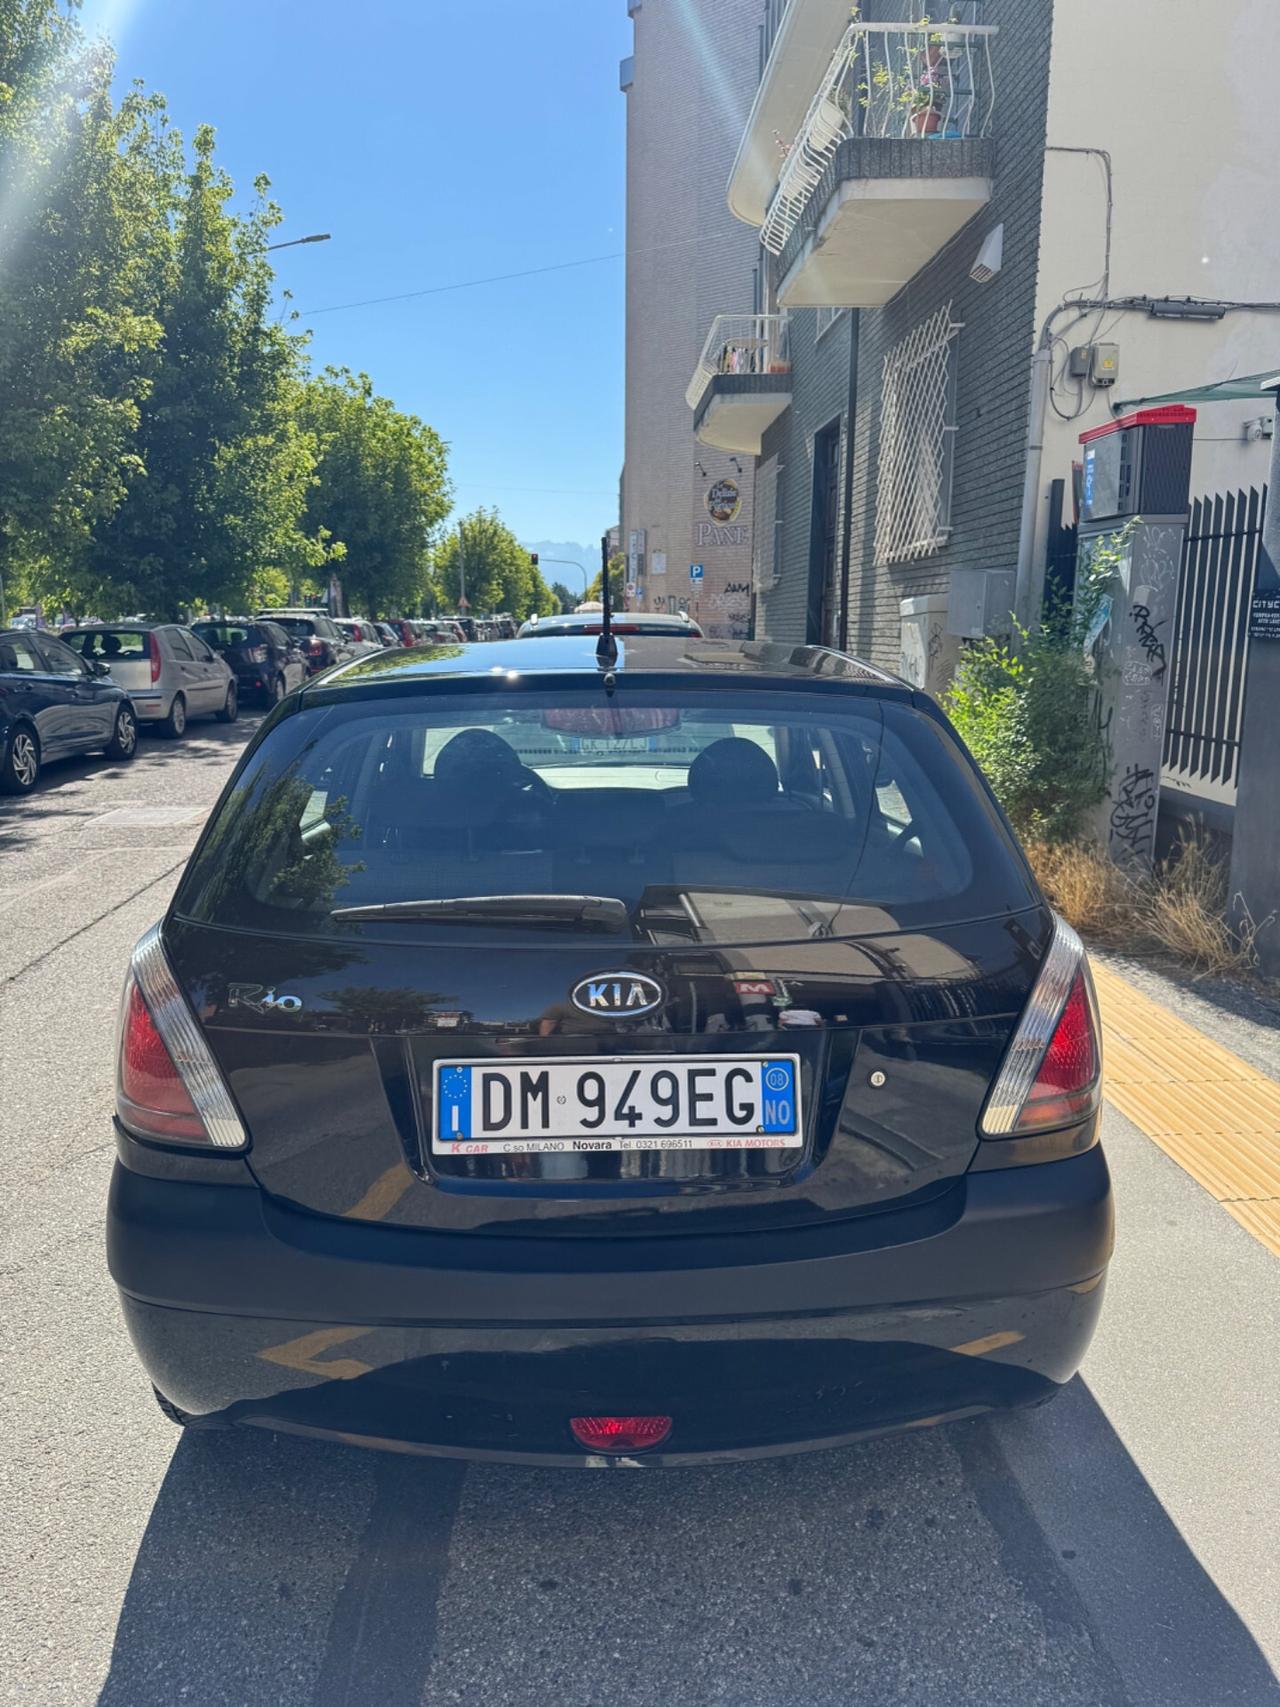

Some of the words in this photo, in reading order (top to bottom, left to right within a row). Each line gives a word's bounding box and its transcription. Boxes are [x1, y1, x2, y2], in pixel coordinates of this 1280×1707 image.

[692, 566, 701, 577] P
[227, 982, 303, 1014] Rio
[587, 983, 648, 1007] KIA
[770, 1073, 784, 1086] 08
[482, 1071, 549, 1131] DM
[576, 1067, 755, 1130] 949EG
[451, 1105, 459, 1131] I
[765, 1099, 790, 1125] NO
[451, 1143, 461, 1153] K
[466, 1144, 489, 1153] CAR
[526, 1141, 565, 1151] MILANO
[572, 1140, 613, 1150] Novara
[635, 1140, 657, 1149] 0321
[726, 1139, 743, 1148] KIA
[744, 1139, 786, 1148] MOTORS
